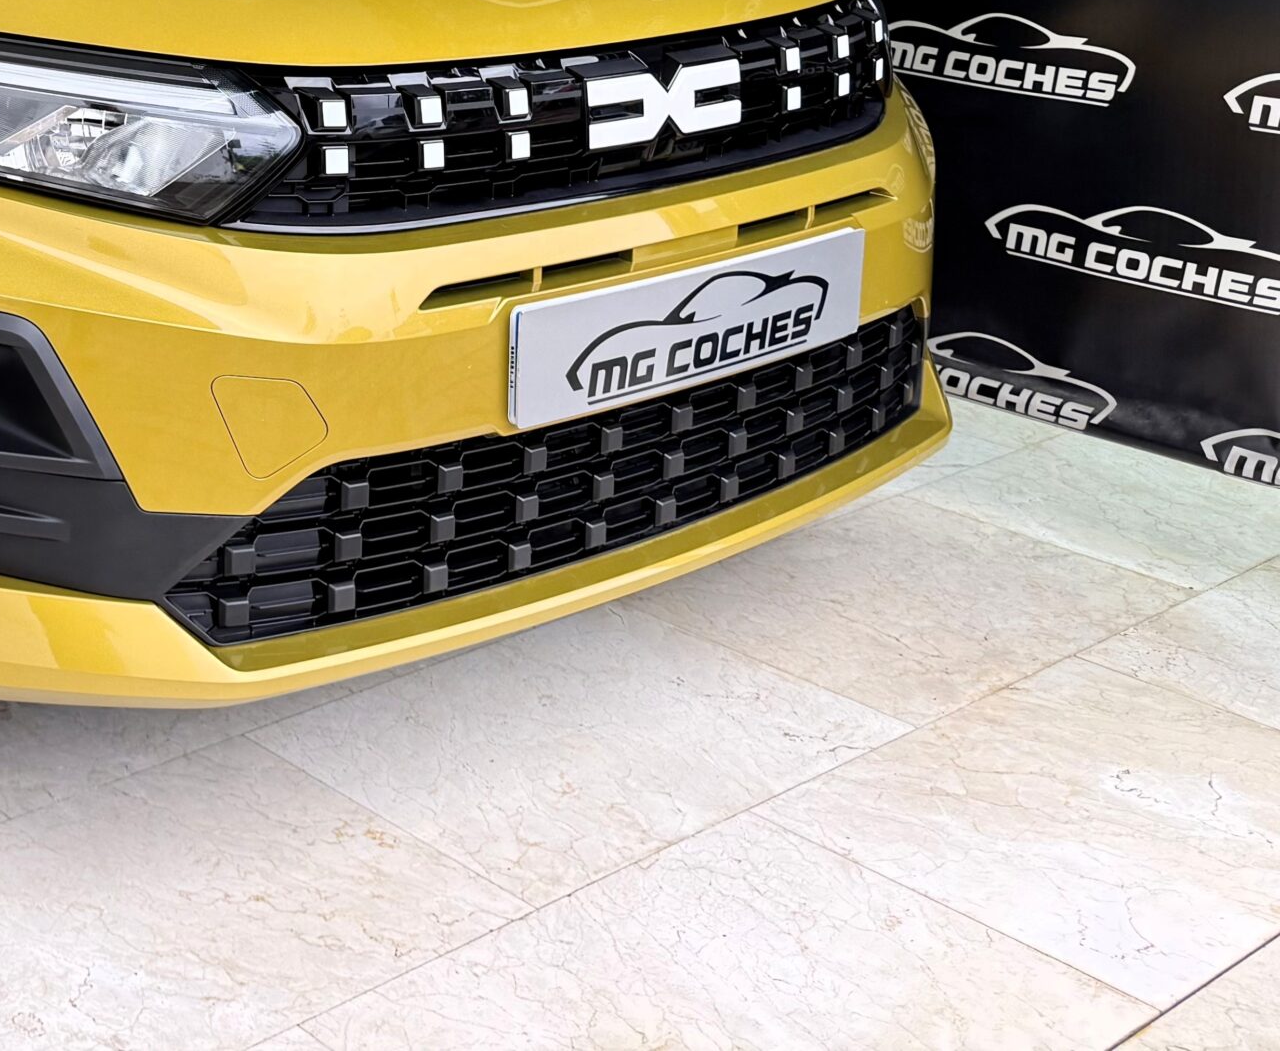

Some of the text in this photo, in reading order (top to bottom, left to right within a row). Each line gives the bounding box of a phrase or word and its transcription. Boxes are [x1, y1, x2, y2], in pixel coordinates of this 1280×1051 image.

[891, 39, 1120, 101] MG COCHES
[1006, 222, 1077, 264] MG
[588, 346, 656, 398] MG
[665, 303, 813, 377] COCHES
[935, 364, 1094, 431] OCHES
[1223, 445, 1280, 486] M
